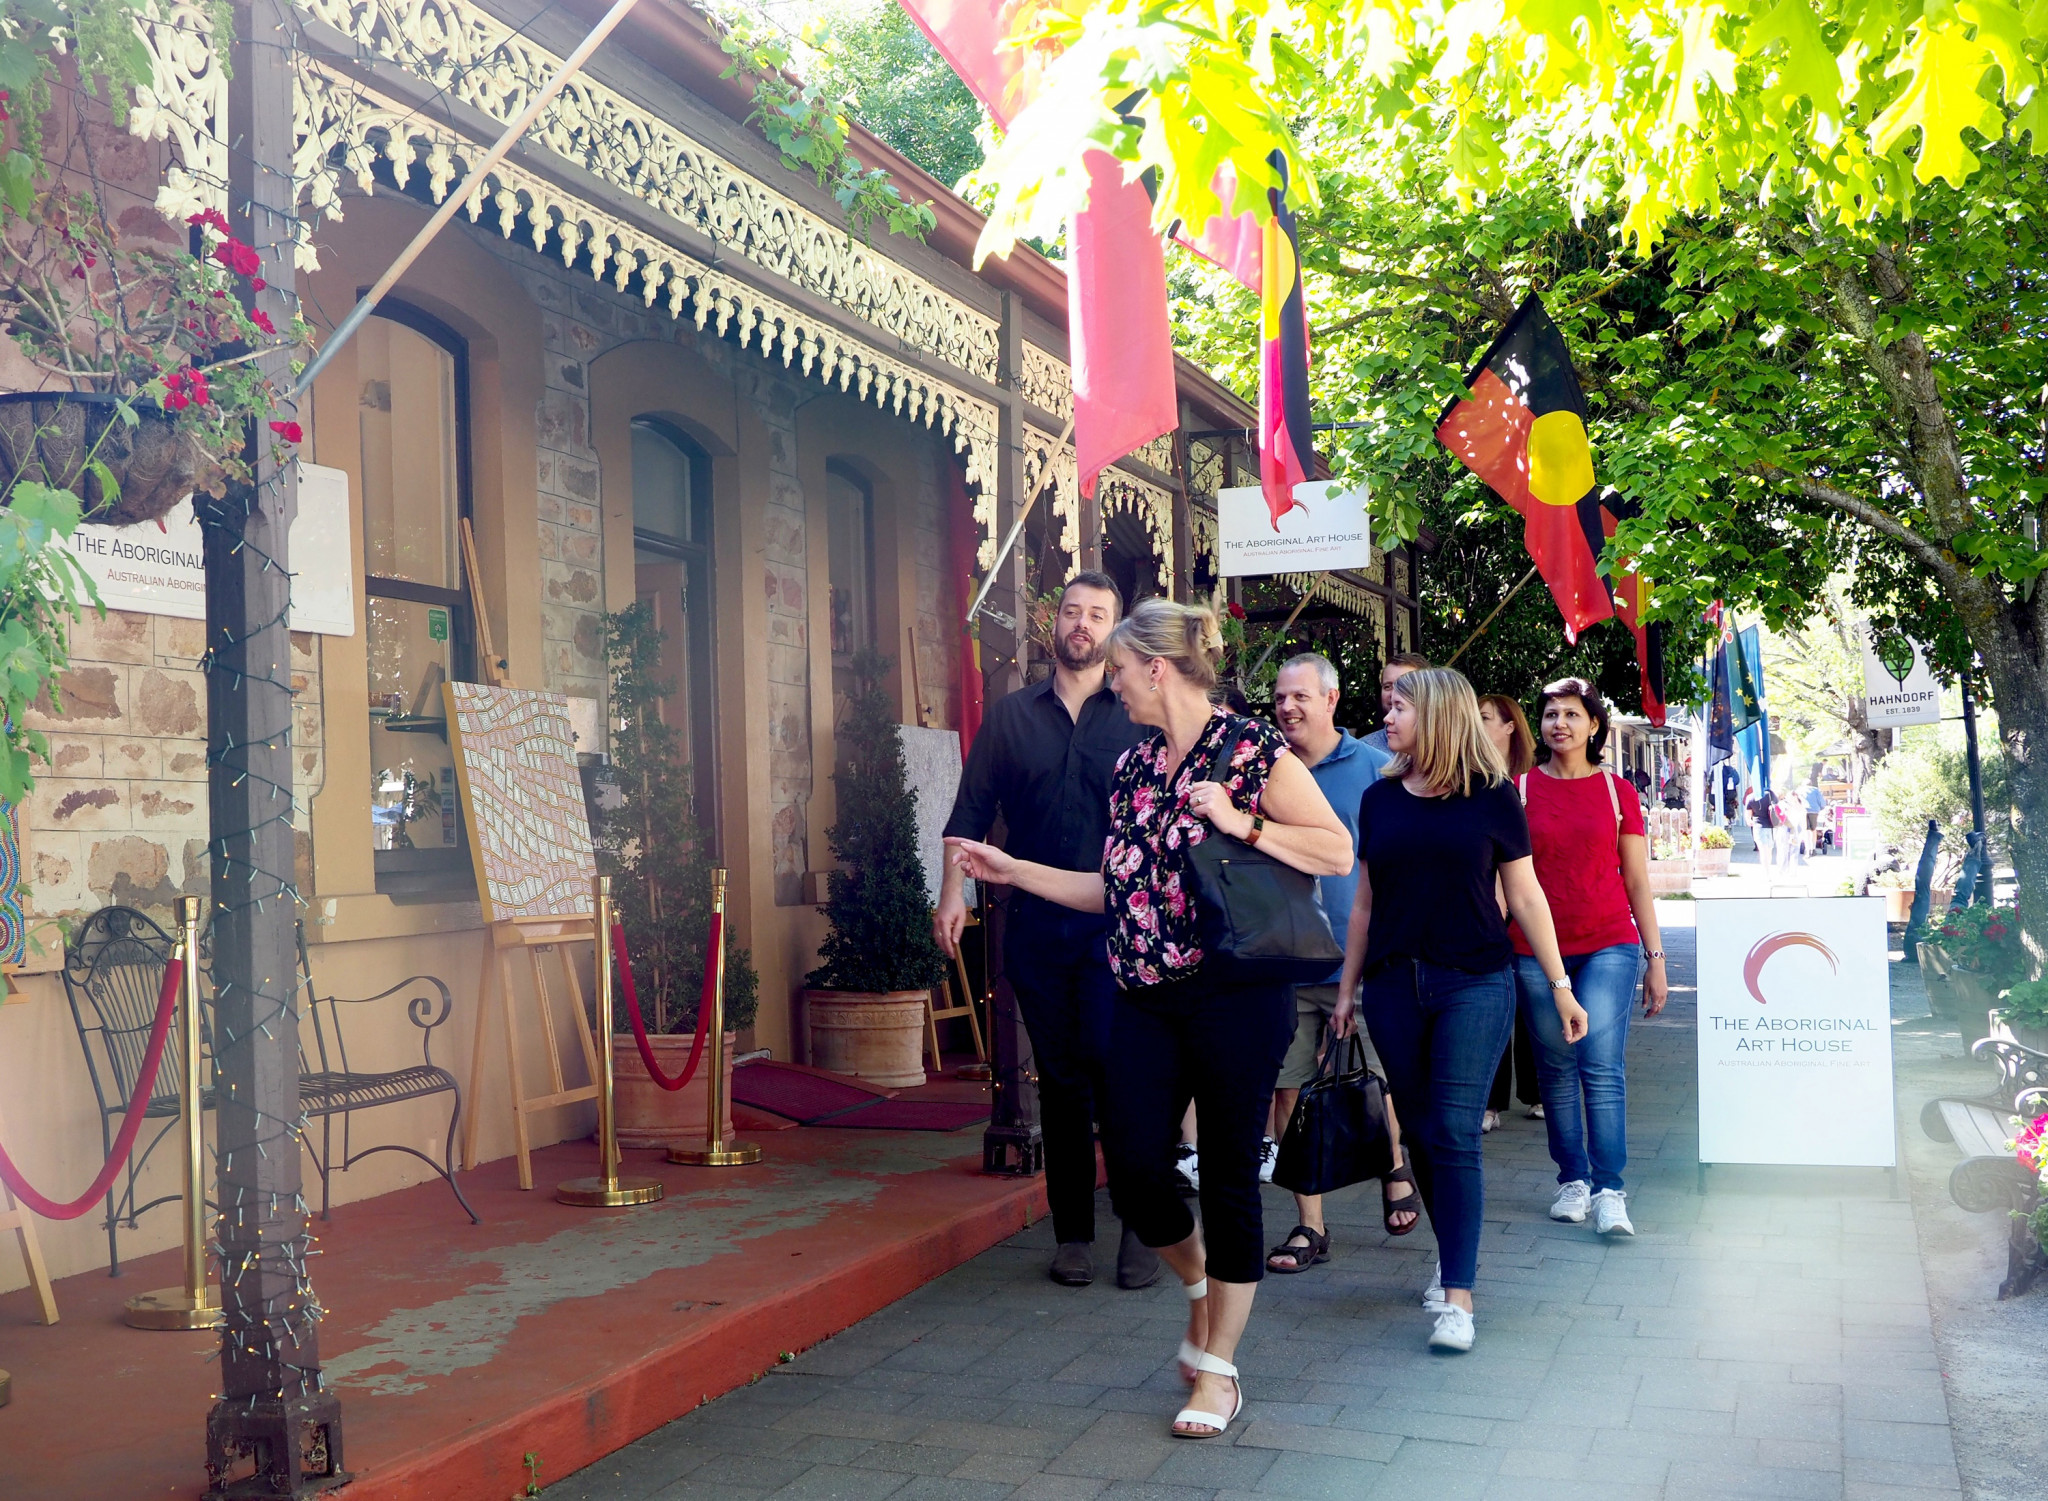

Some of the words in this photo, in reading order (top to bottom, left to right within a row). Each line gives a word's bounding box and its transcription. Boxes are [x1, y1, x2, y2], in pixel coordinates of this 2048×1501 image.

[1224, 540, 1244, 549] THE
[1246, 537, 1304, 548] ABORIGINAL
[1306, 535, 1326, 544] ART
[1328, 533, 1363, 542] HOUSE
[73, 531, 107, 556] THE
[111, 538, 205, 570] ABORIGINAL
[107, 568, 165, 587] AUSTRALIAN
[1869, 691, 1934, 706] HAHNDORF
[1902, 706, 1920, 714] 1839
[1709, 1016, 1749, 1031] THE
[1755, 1016, 1878, 1031] ABORIGINAL
[1736, 1037, 1775, 1052] ART
[1782, 1038, 1853, 1052] HOUSE
[1717, 1059, 1772, 1068] AUSTRALIAN
[1775, 1059, 1828, 1068] ABORIGINAL
